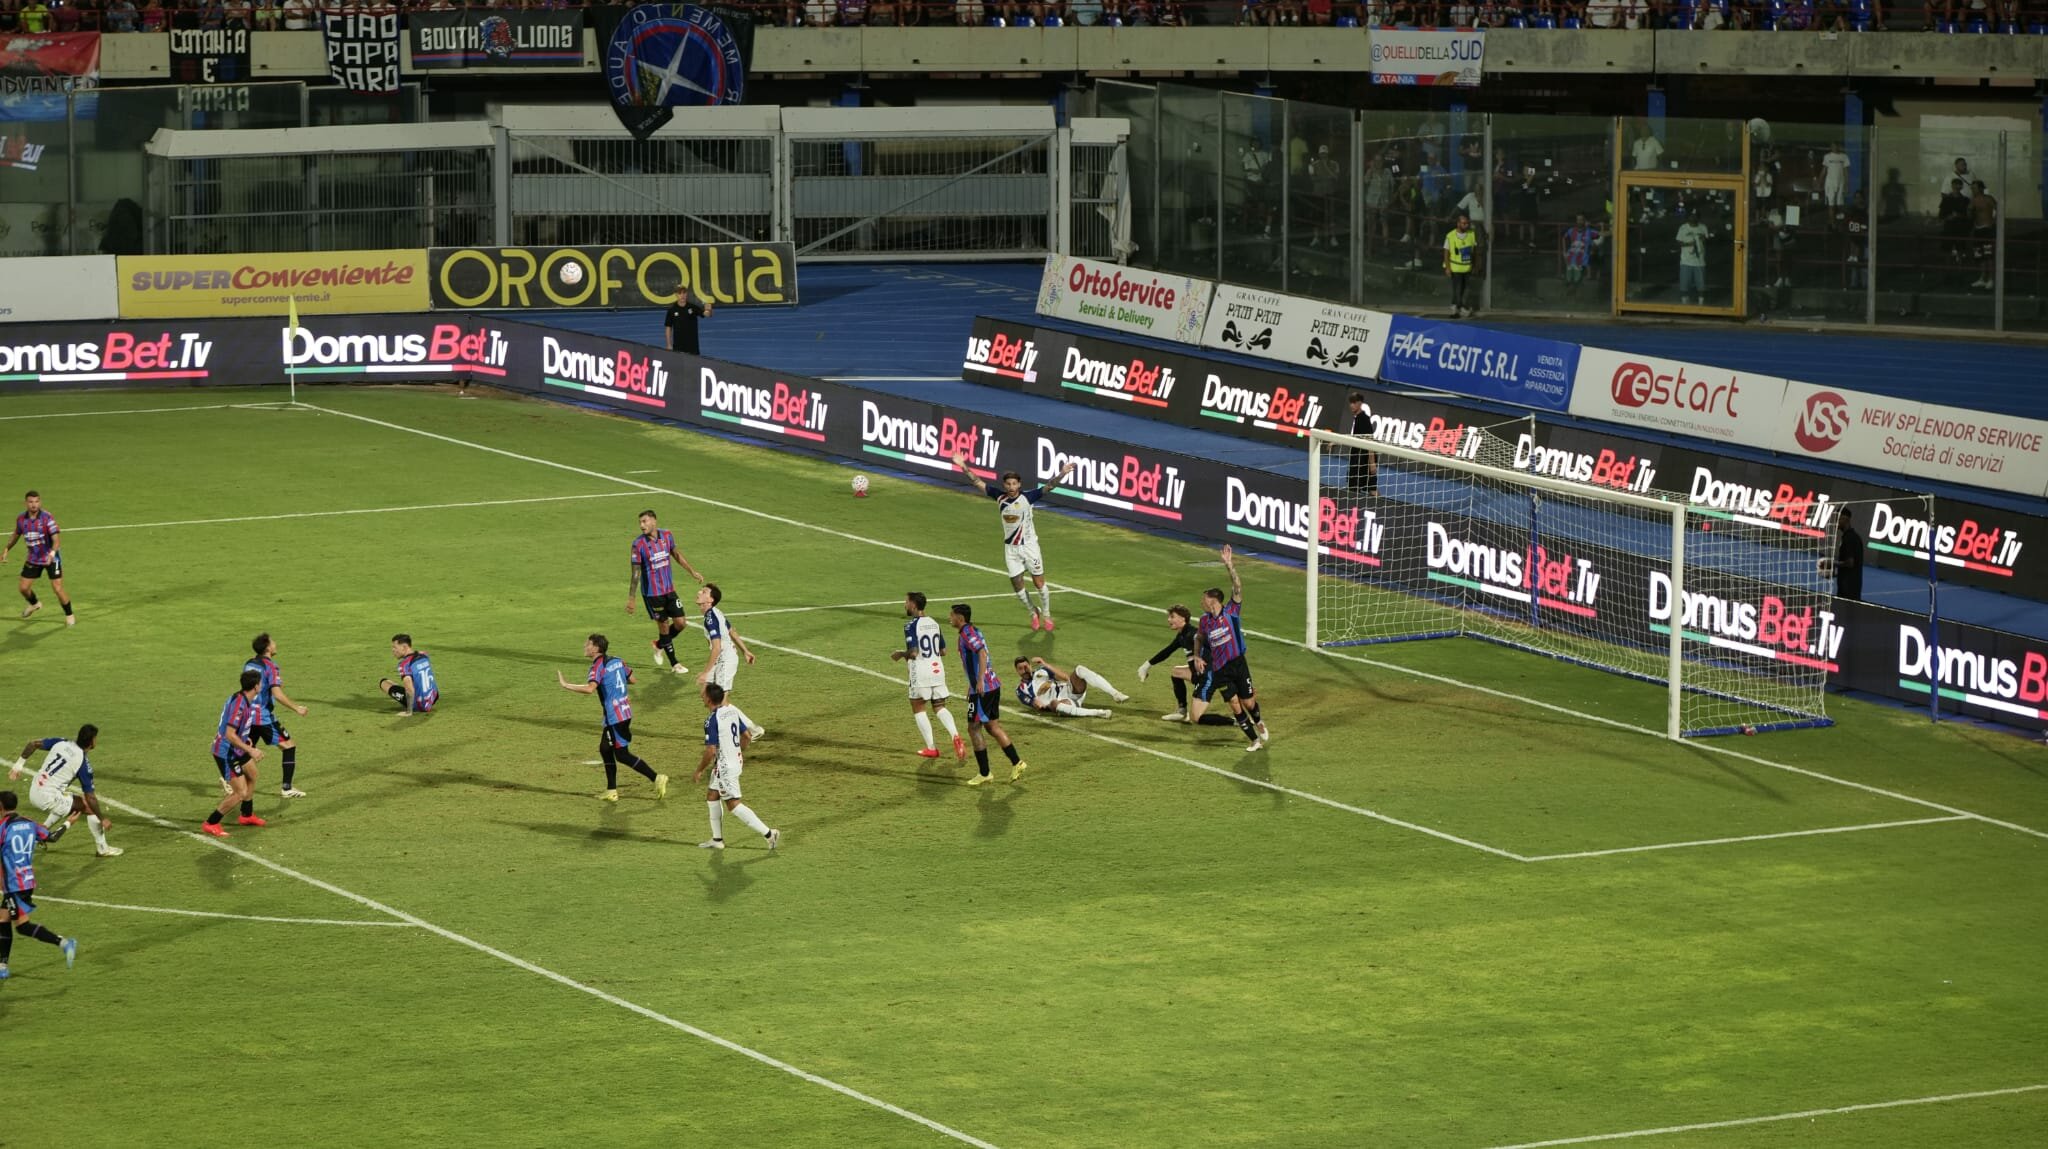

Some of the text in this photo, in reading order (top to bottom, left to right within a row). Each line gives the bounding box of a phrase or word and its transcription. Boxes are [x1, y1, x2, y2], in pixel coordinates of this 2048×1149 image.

[420, 25, 573, 51] SOUTH LIONS
[331, 64, 398, 92] SARO
[1372, 74, 1416, 85] CATANIA
[1069, 263, 1175, 310] OrtoService
[1078, 300, 1154, 330] Servizi & Delivery
[1391, 332, 1434, 360] FAAC
[1438, 342, 1482, 375] CESIT
[543, 336, 668, 397] DomusBet.Tv
[1061, 346, 1175, 400] DomusBet.Tv
[1528, 367, 1565, 383] ASSISTENZA
[701, 367, 828, 432] DomusBet.Tv
[1201, 374, 1322, 429] DomusBet.Tv
[1525, 380, 1565, 396] RIPARAZIONE
[862, 400, 1000, 469] DomusBet.Tv
[1860, 408, 2043, 453] NEW SPLENDOR SERVICE
[1514, 433, 1656, 493] DomusBet.Tv
[1882, 435, 2006, 473] Società di servizi
[1037, 436, 1187, 510] DomusBet.Tv
[1689, 466, 1835, 529] DomusBet.Tv
[919, 634, 940, 659] 90
[418, 668, 434, 693] 16
[615, 669, 625, 694] 4
[730, 722, 740, 748] 8
[11, 833, 35, 860] 04
